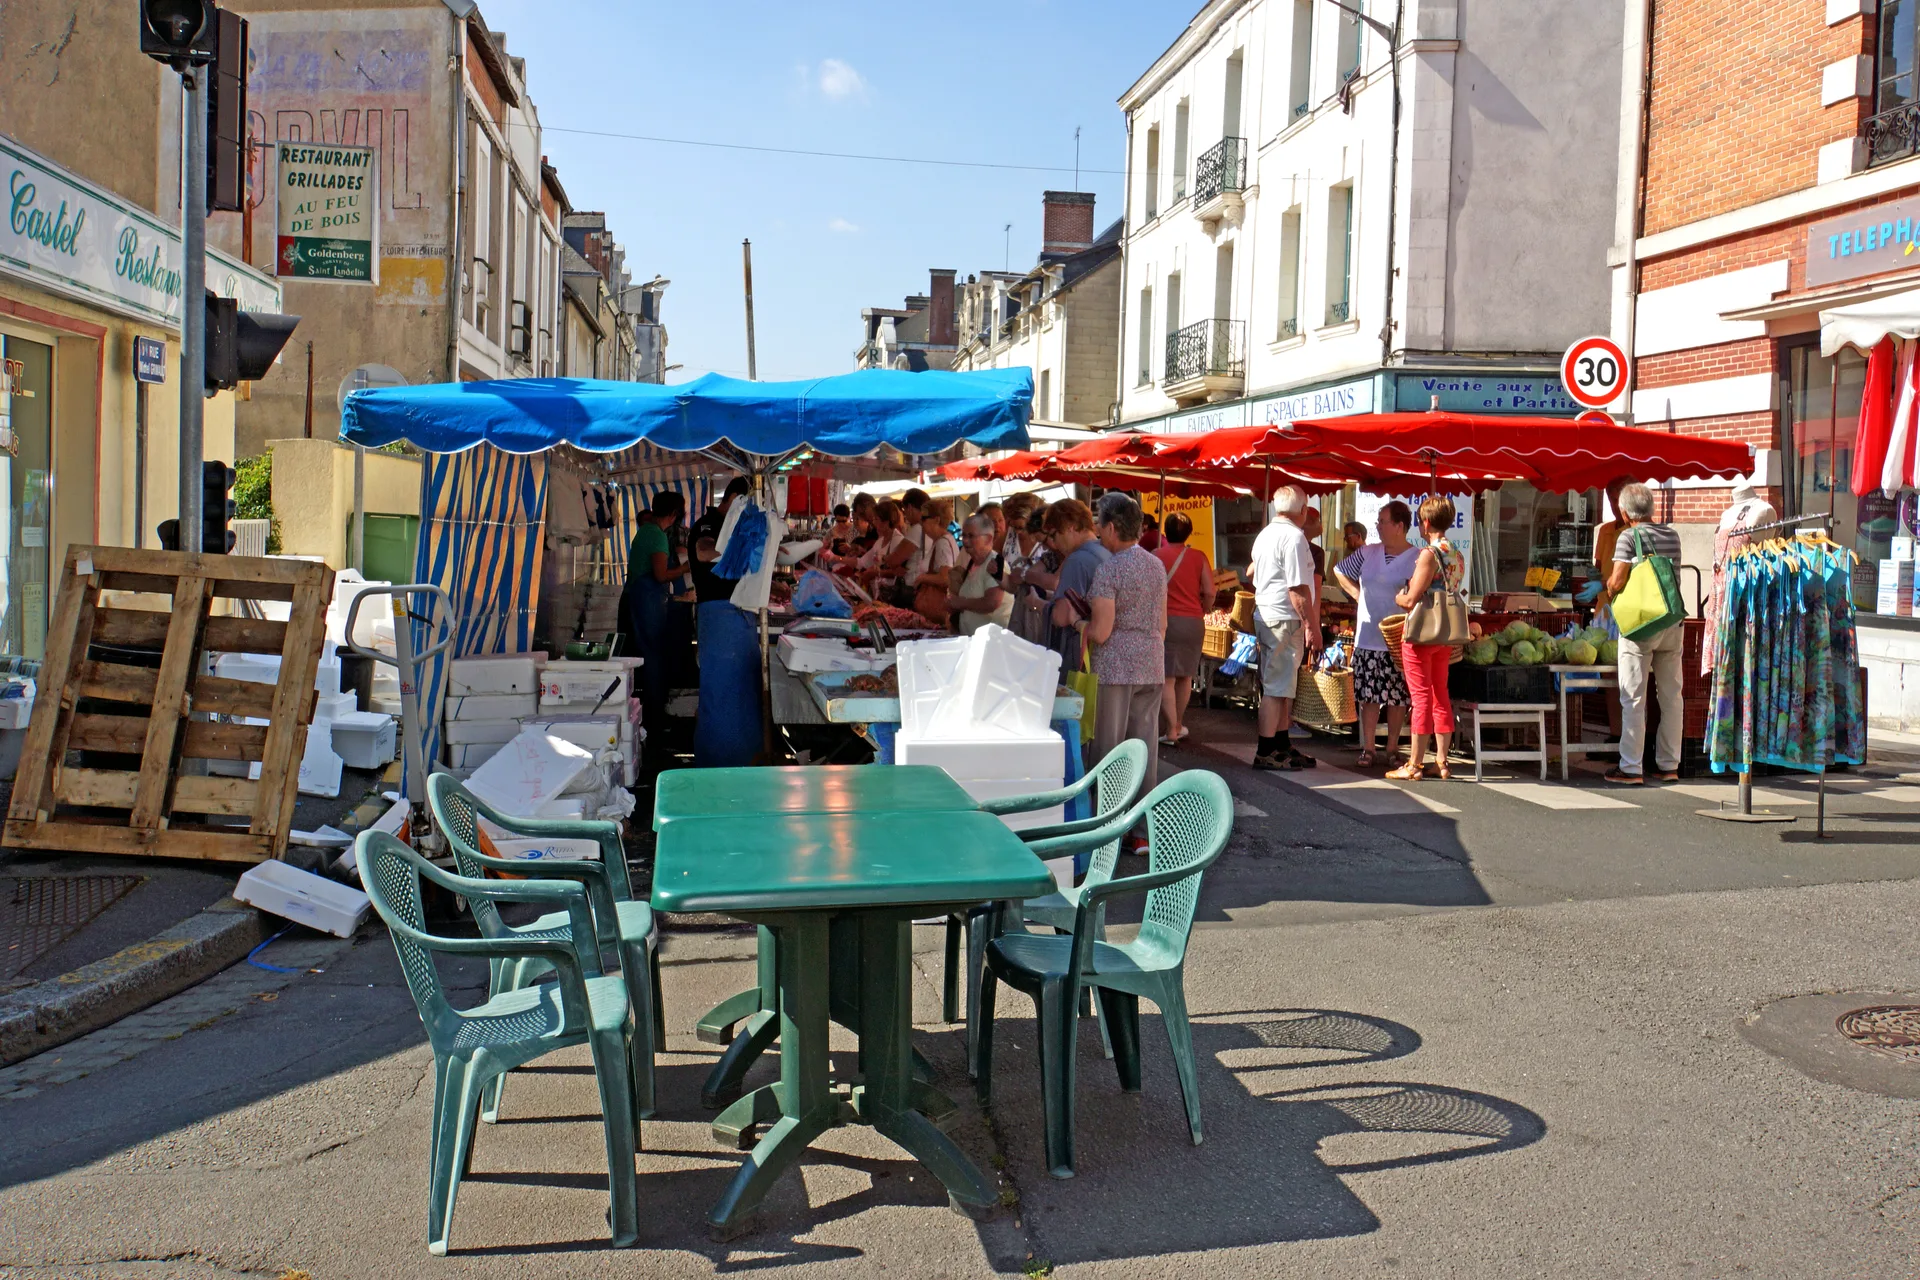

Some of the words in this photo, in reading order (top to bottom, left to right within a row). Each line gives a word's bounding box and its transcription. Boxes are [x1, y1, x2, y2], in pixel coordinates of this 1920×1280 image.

[280, 147, 370, 168] RESTAURANT
[287, 171, 364, 191] GRILLADES
[294, 200, 318, 215] AU
[325, 194, 359, 210] FEU
[291, 218, 314, 233] DE
[321, 211, 361, 229] BOIS
[9, 169, 86, 257] Castel
[115, 226, 182, 299] Restaur
[308, 248, 365, 261] Goldenberg
[308, 264, 330, 276] Saint
[333, 265, 365, 278] Landelin
[149, 345, 160, 359] RUE
[1577, 357, 1617, 387] 30
[1422, 378, 1483, 393] Vente
[1496, 382, 1532, 393] aux
[1544, 382, 1563, 394] pr
[1265, 396, 1309, 422] ESPACE
[1314, 387, 1355, 413] BAINS
[1482, 398, 1503, 409] et
[1512, 394, 1581, 409] Partic
